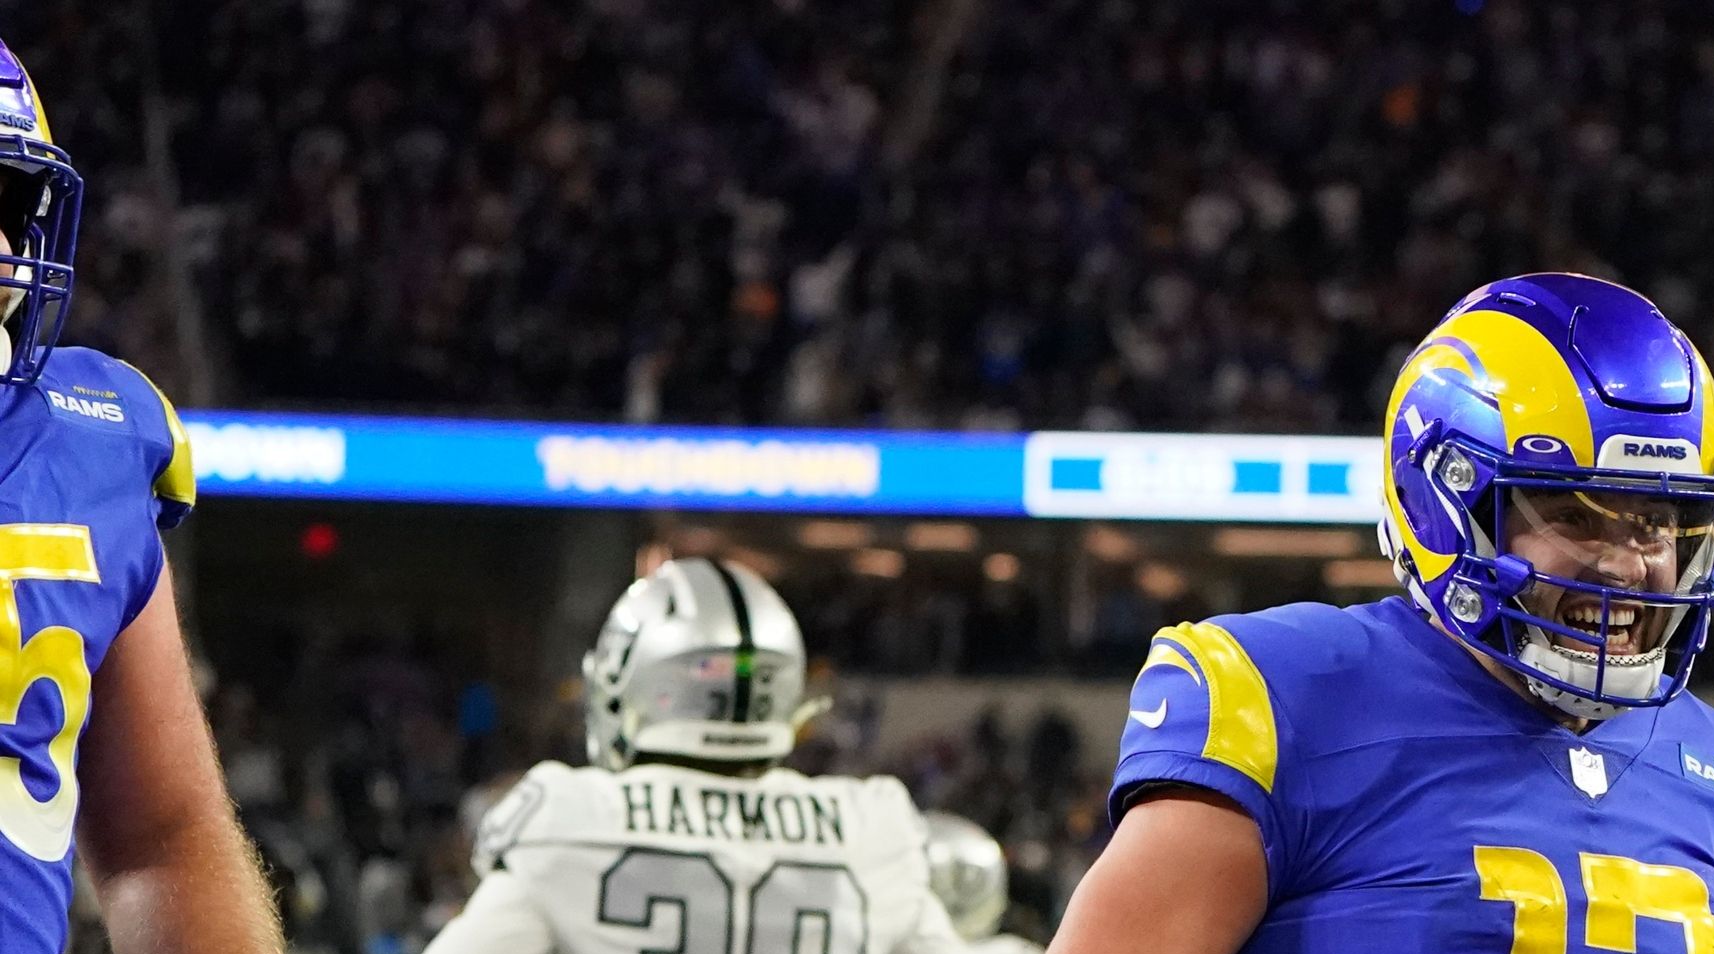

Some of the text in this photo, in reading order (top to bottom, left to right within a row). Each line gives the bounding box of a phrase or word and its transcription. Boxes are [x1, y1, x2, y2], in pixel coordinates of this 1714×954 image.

[0, 112, 35, 132] AMS
[47, 390, 125, 423] RAMS
[1623, 442, 1688, 460] RAMS
[621, 783, 846, 845] HARMON
